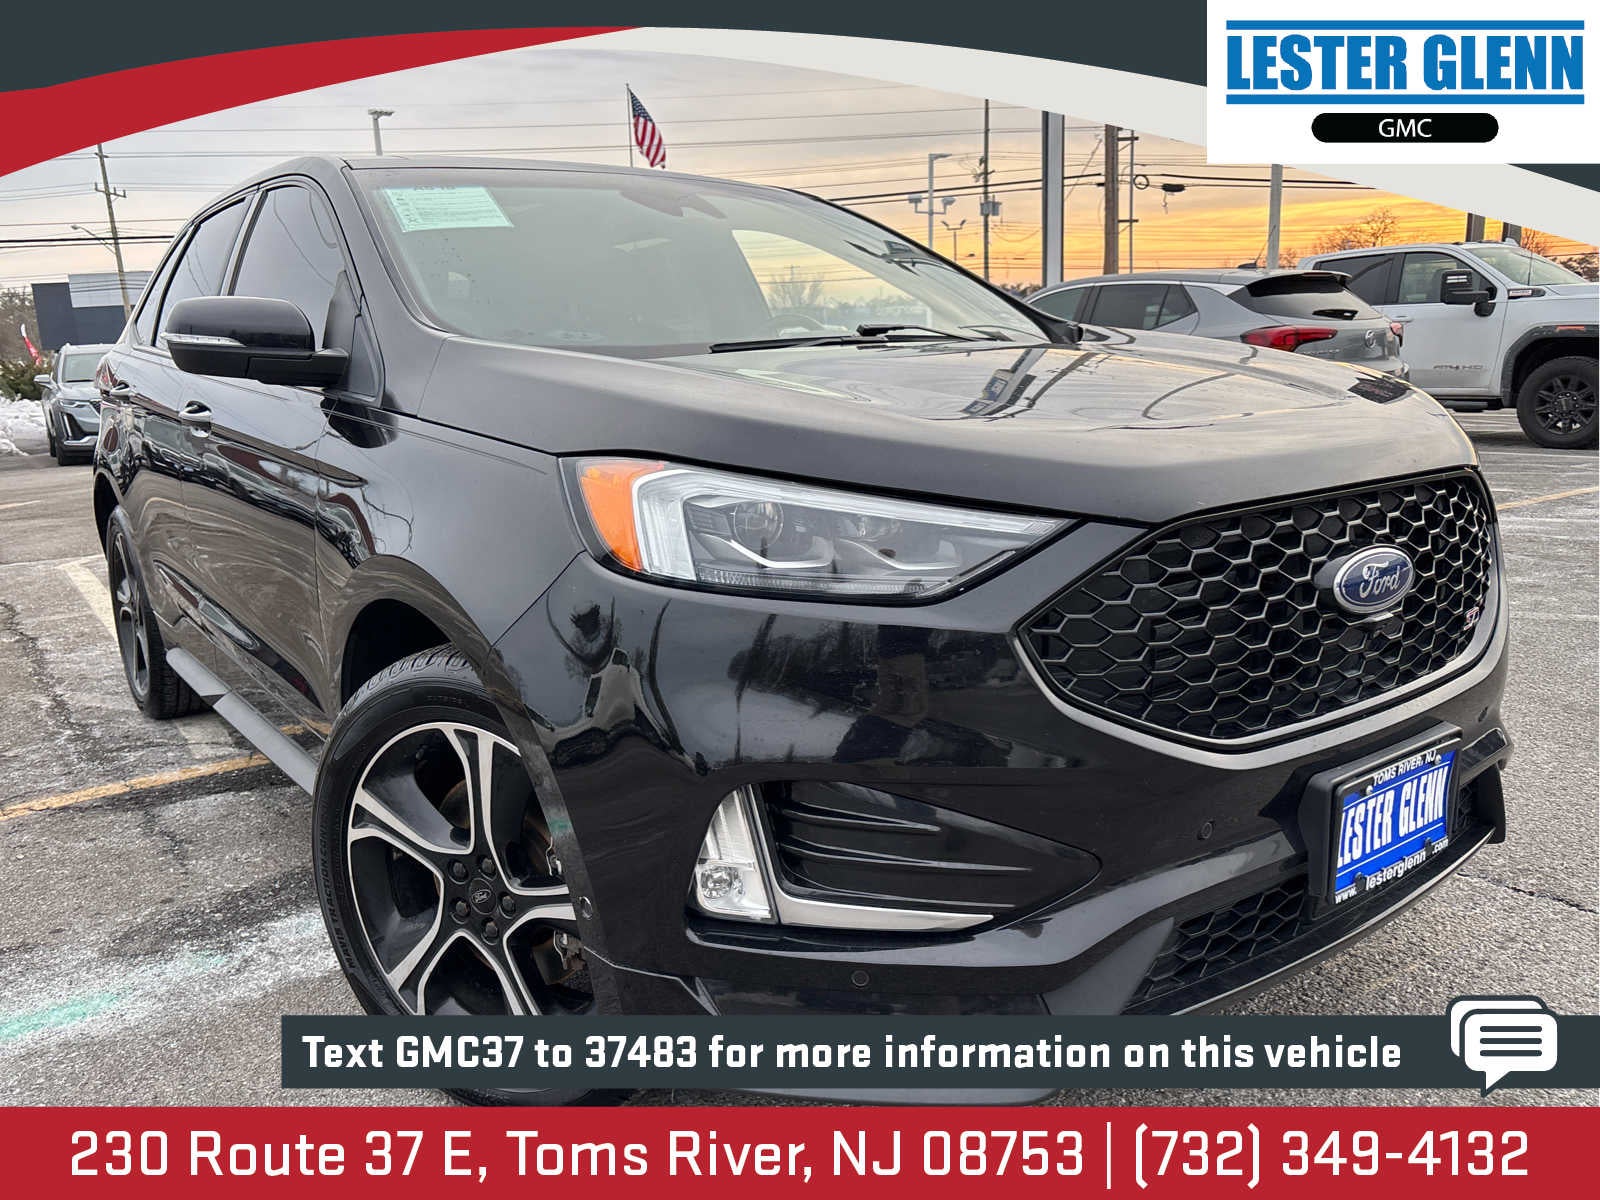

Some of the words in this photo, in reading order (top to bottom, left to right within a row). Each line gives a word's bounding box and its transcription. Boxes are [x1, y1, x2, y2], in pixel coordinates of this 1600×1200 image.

[1359, 560, 1401, 599] Ford
[1372, 766, 1397, 785] TOMS
[1424, 750, 1437, 764] NJ
[1337, 789, 1395, 868] LESTER
[1399, 766, 1448, 835] GLENN
[1366, 852, 1426, 890] lesterglenn
